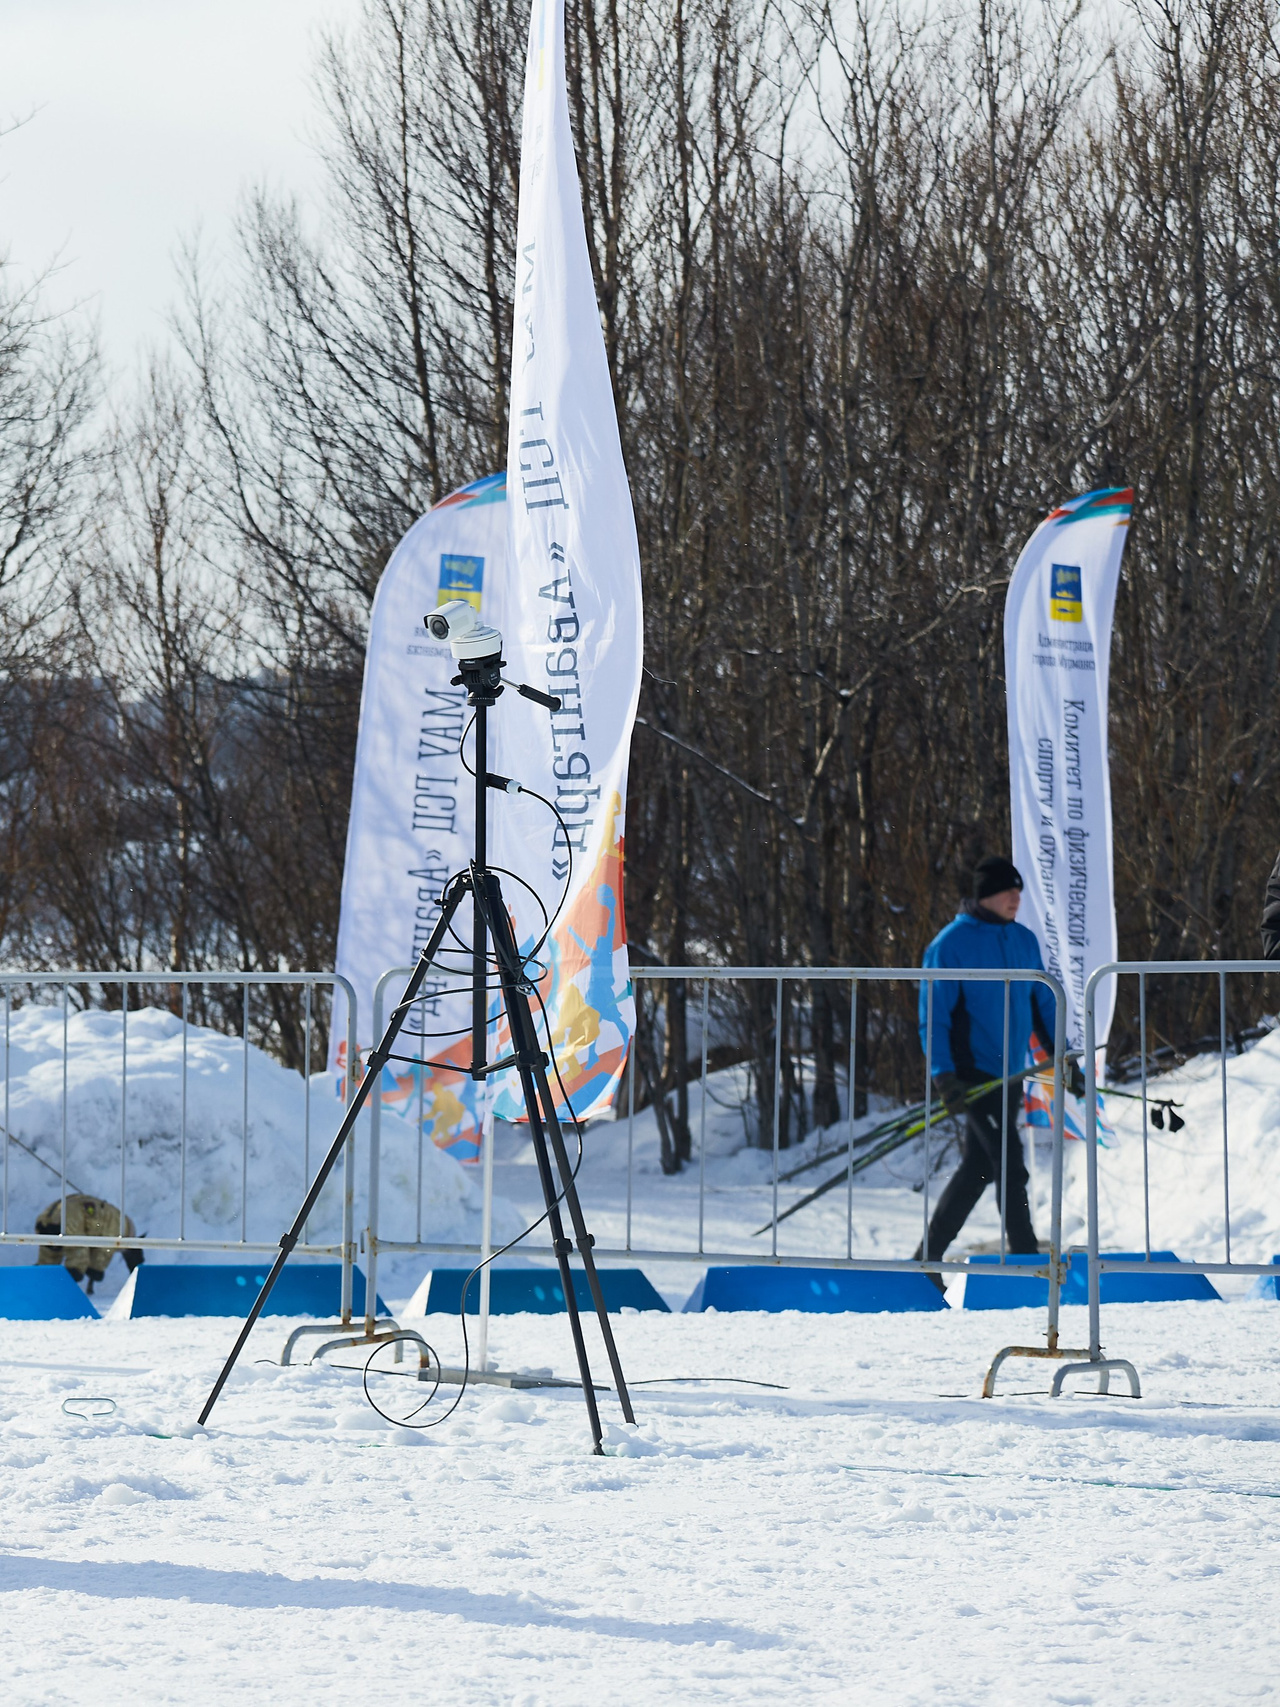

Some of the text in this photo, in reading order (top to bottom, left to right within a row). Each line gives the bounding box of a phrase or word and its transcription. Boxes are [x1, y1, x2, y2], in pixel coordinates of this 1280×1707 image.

[1035, 737, 1054, 808] спорту
[1064, 699, 1086, 791] Комитет
[1040, 815, 1054, 827] и
[1067, 797, 1085, 820] по
[1064, 827, 1090, 948] физической
